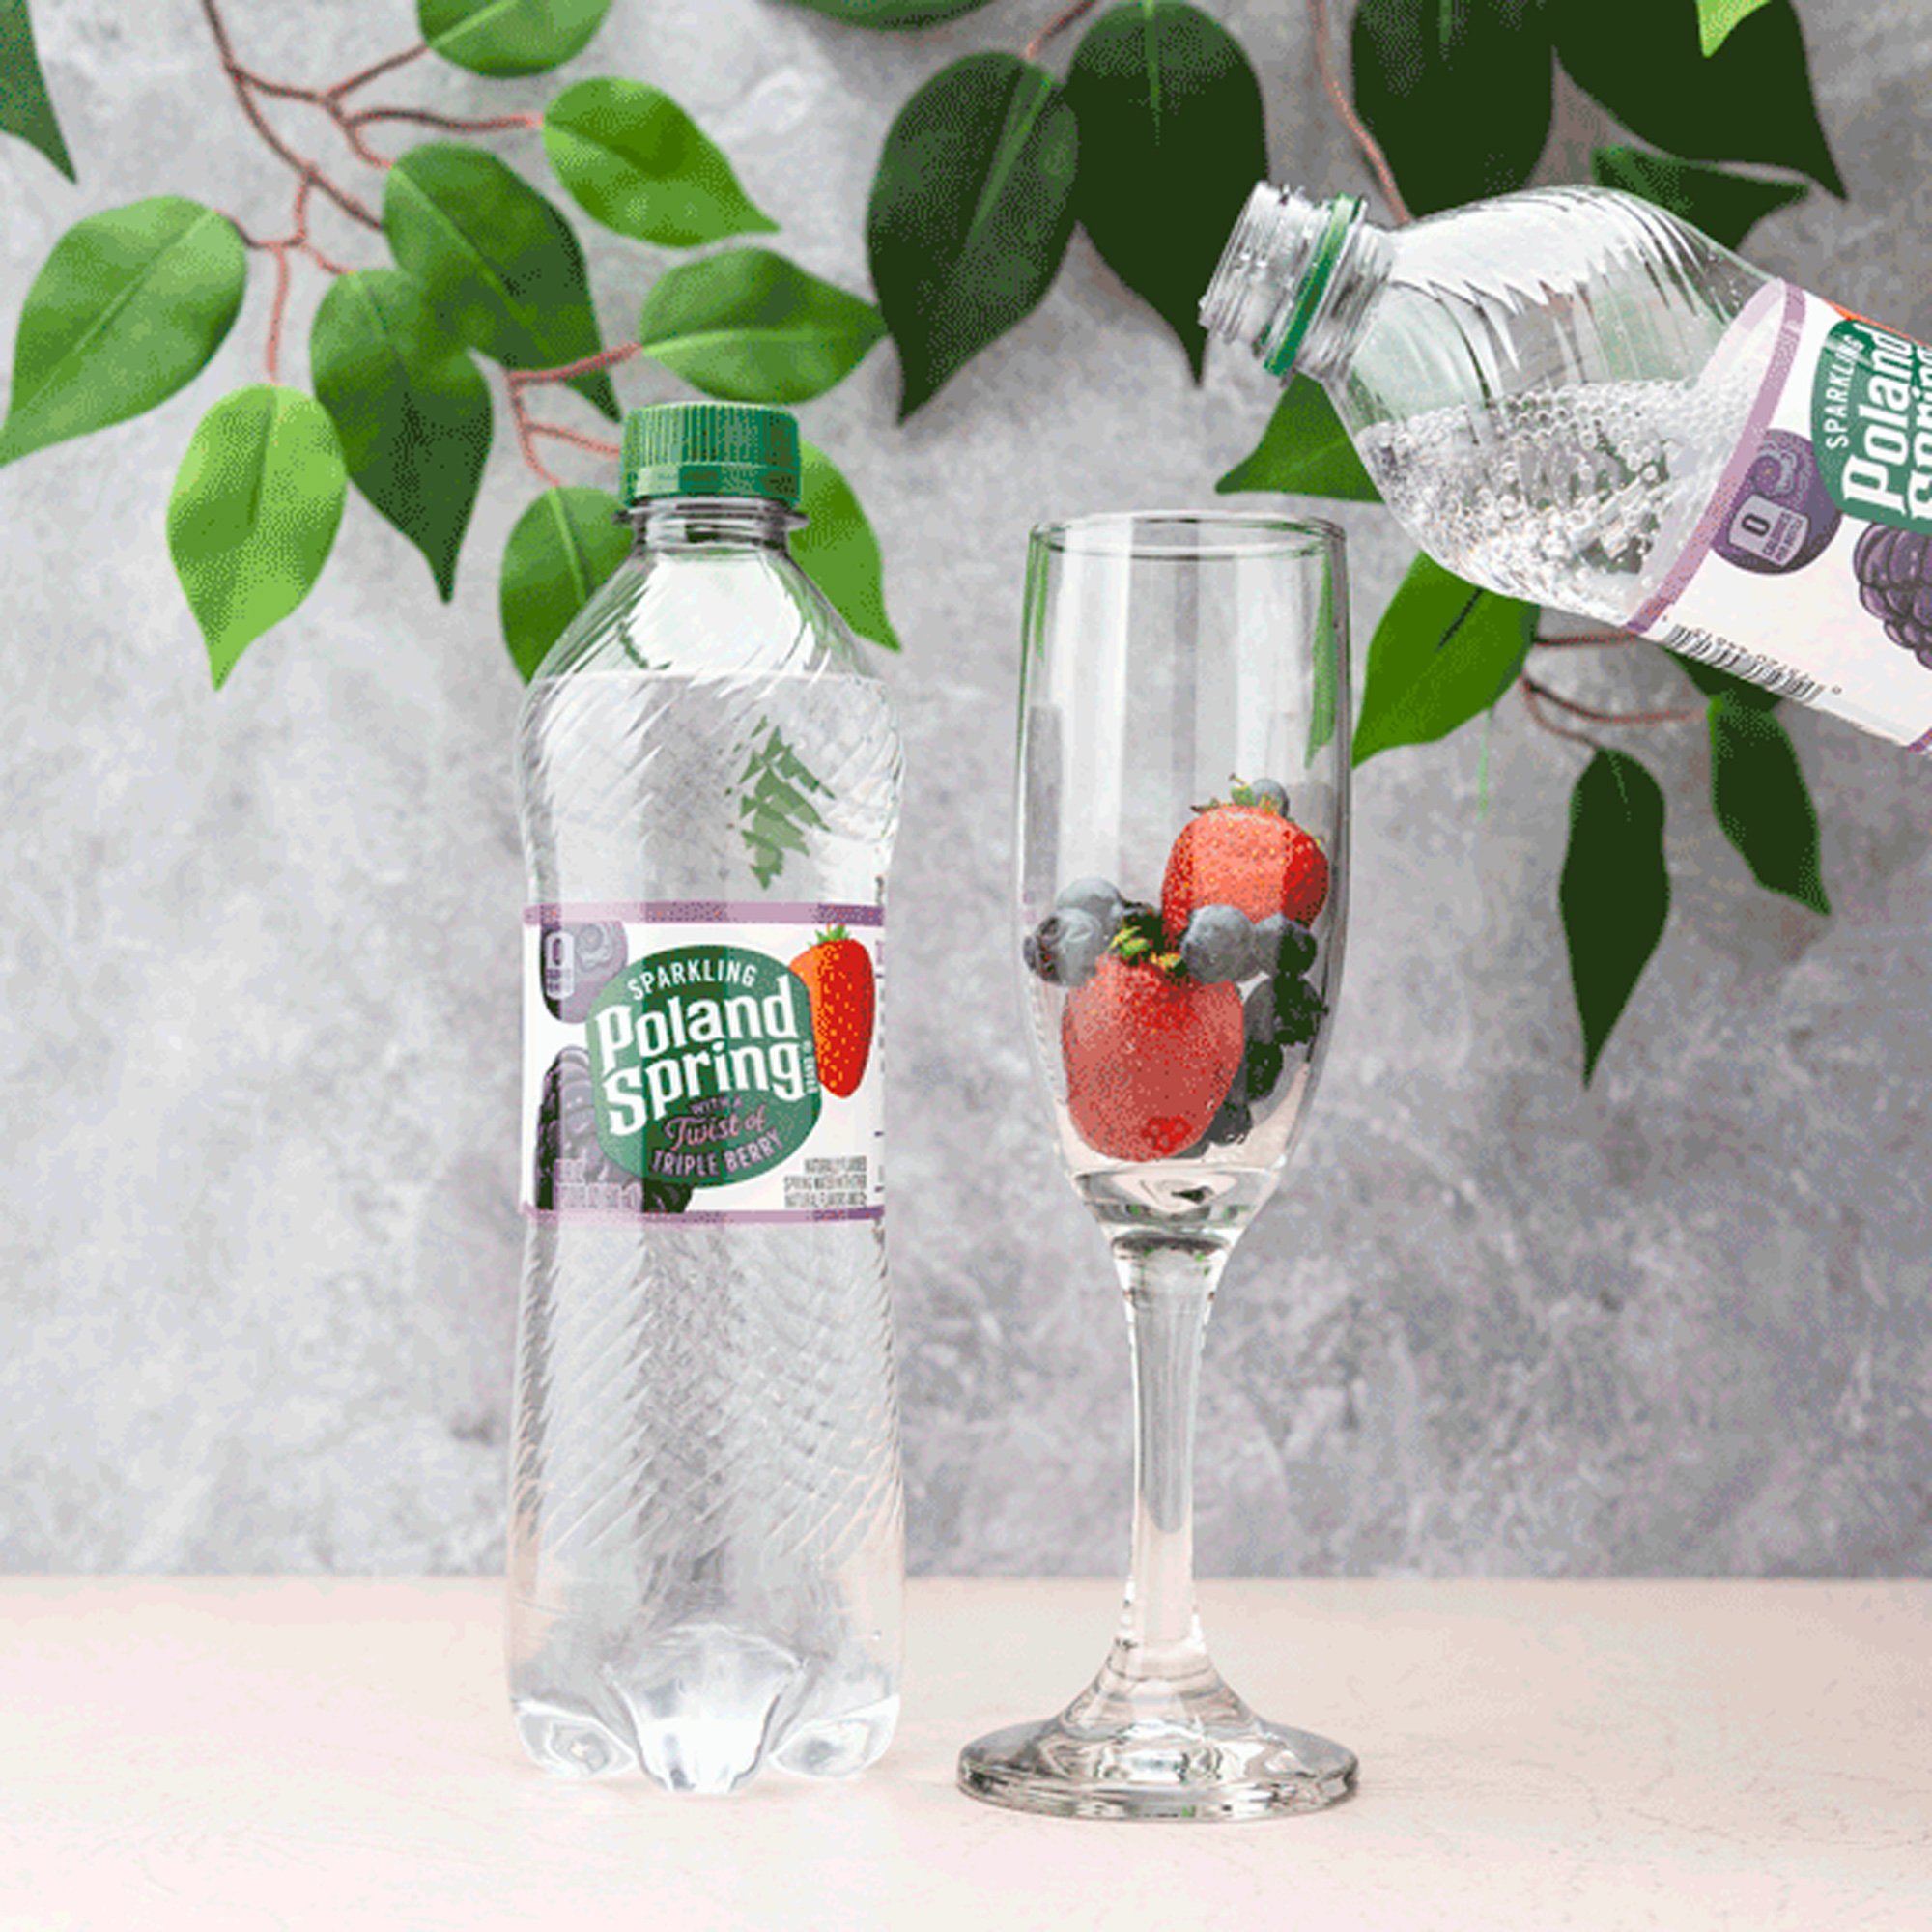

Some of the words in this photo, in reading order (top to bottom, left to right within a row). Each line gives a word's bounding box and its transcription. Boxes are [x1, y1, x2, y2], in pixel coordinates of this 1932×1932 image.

[1824, 334, 1864, 449] SPARKLING
[1841, 322, 1914, 516] Poland
[1741, 513, 1771, 537] 0
[628, 959, 757, 1000] SPARKLING
[595, 974, 799, 1079] Poland
[603, 1040, 807, 1136] Spring
[652, 1150, 718, 1177] TRIPLE
[724, 1126, 784, 1174] BERRY
[665, 1112, 740, 1151] Twist
[744, 1103, 767, 1132] of
